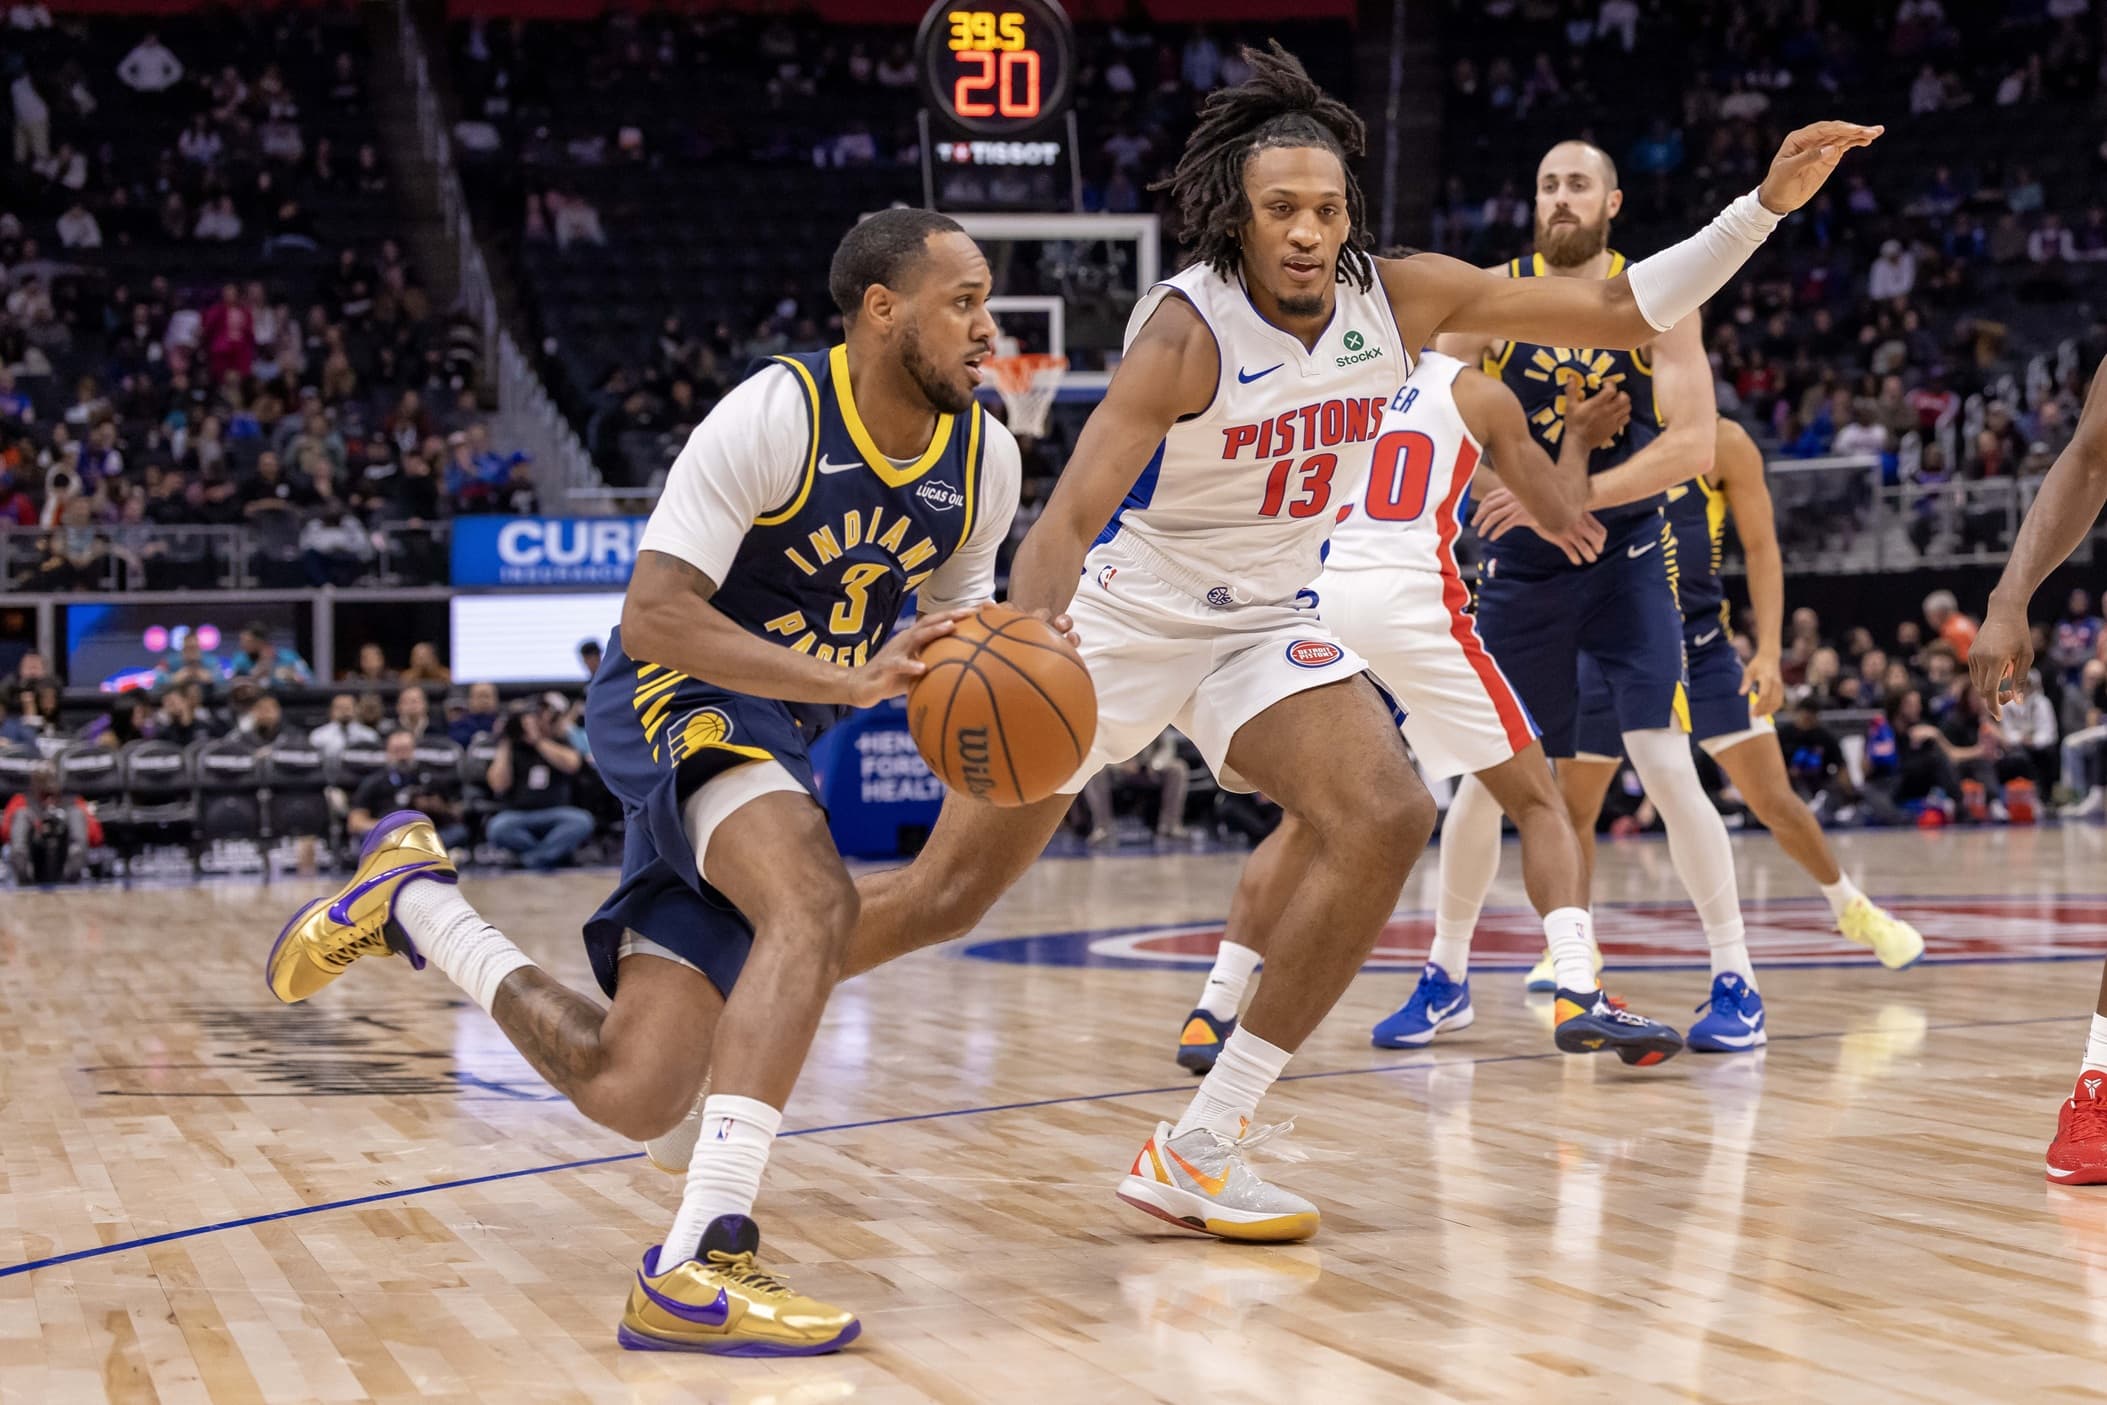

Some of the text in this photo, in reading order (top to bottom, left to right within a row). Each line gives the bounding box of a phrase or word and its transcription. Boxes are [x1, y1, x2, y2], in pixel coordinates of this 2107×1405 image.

[948, 11, 1026, 51] 39.5
[955, 50, 1040, 118] 20
[970, 142, 1061, 166] TISSOT
[1336, 347, 1384, 368] StockX
[1222, 396, 1388, 460] PISTONS
[916, 484, 964, 507] LUCAS OIL
[1258, 452, 1338, 519] 13
[1335, 429, 1435, 524] 0
[829, 562, 891, 635] 3
[764, 610, 884, 668] PACER
[957, 726, 997, 802] Wils
